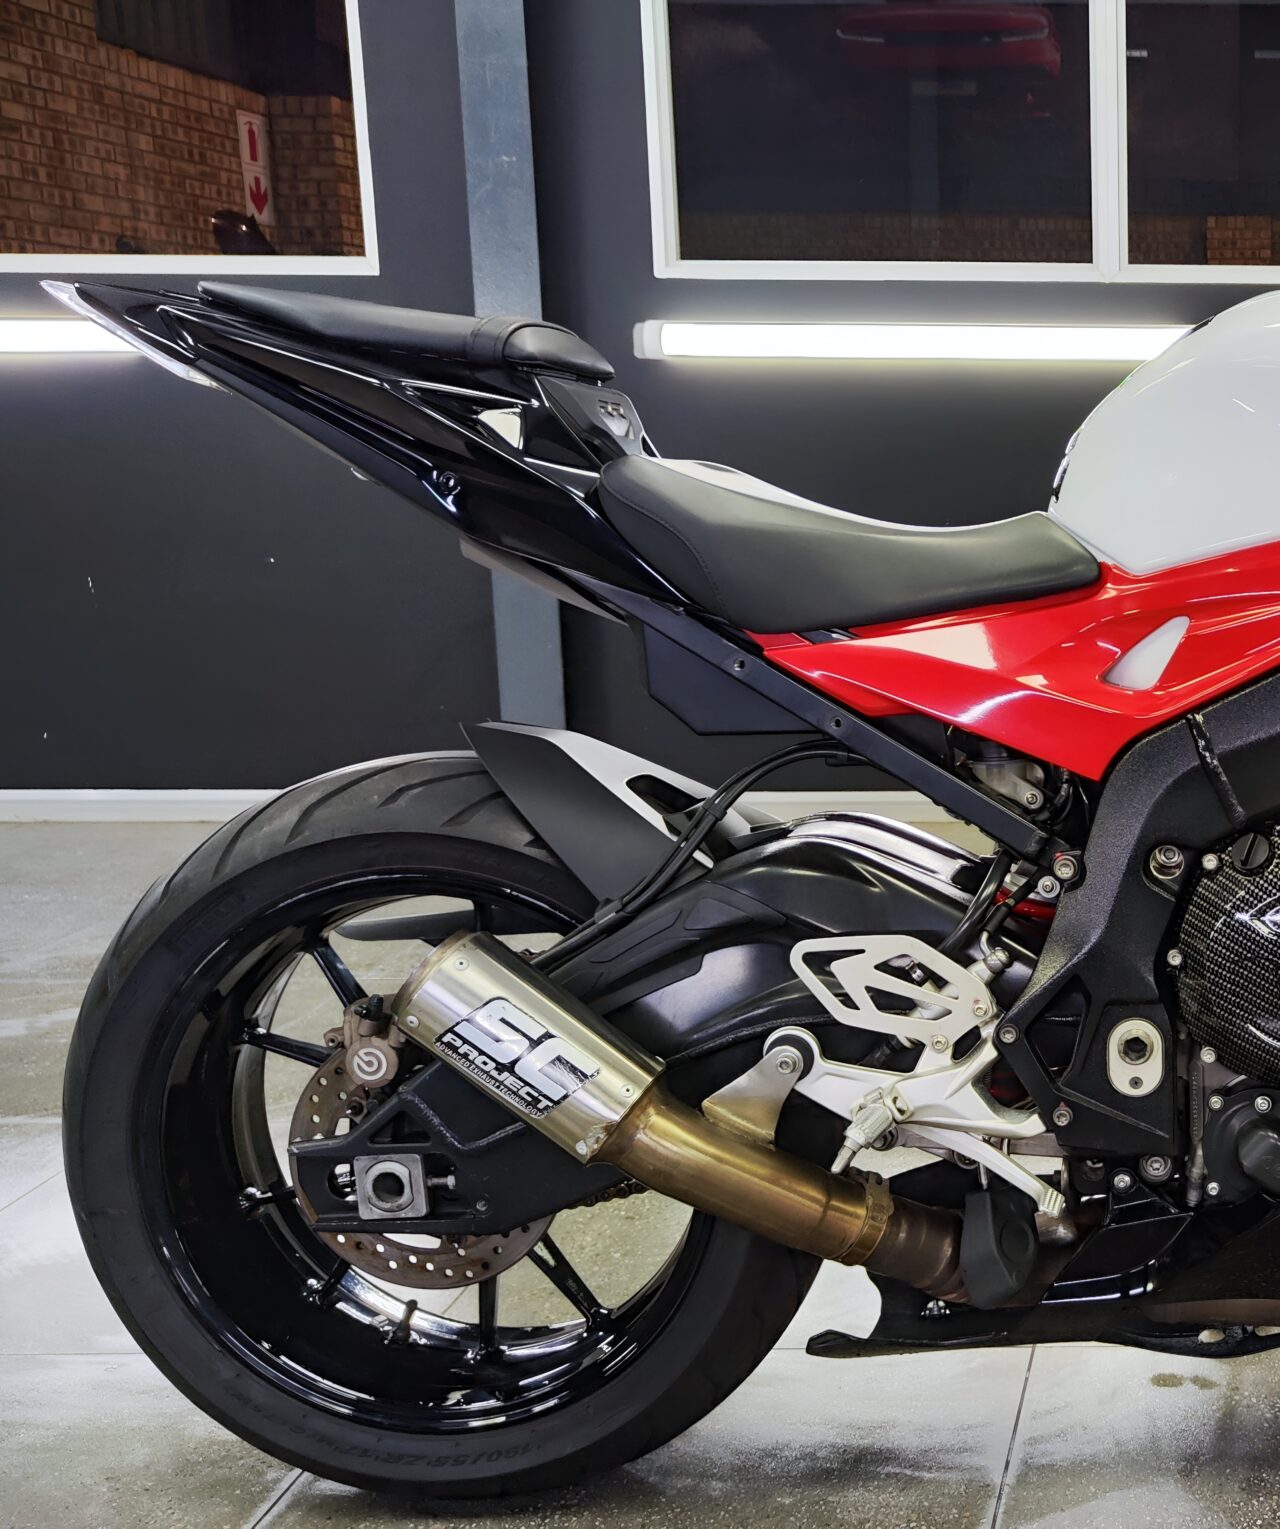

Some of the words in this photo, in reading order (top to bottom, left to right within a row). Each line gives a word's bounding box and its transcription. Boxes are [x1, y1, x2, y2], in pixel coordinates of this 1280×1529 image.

[434, 1041, 471, 1070] ADVANCED
[468, 1064, 500, 1090] EXHAUST
[497, 1083, 543, 1118] TECHNOLOGY
[441, 1032, 554, 1110] PROJECT
[453, 998, 600, 1101] SC
